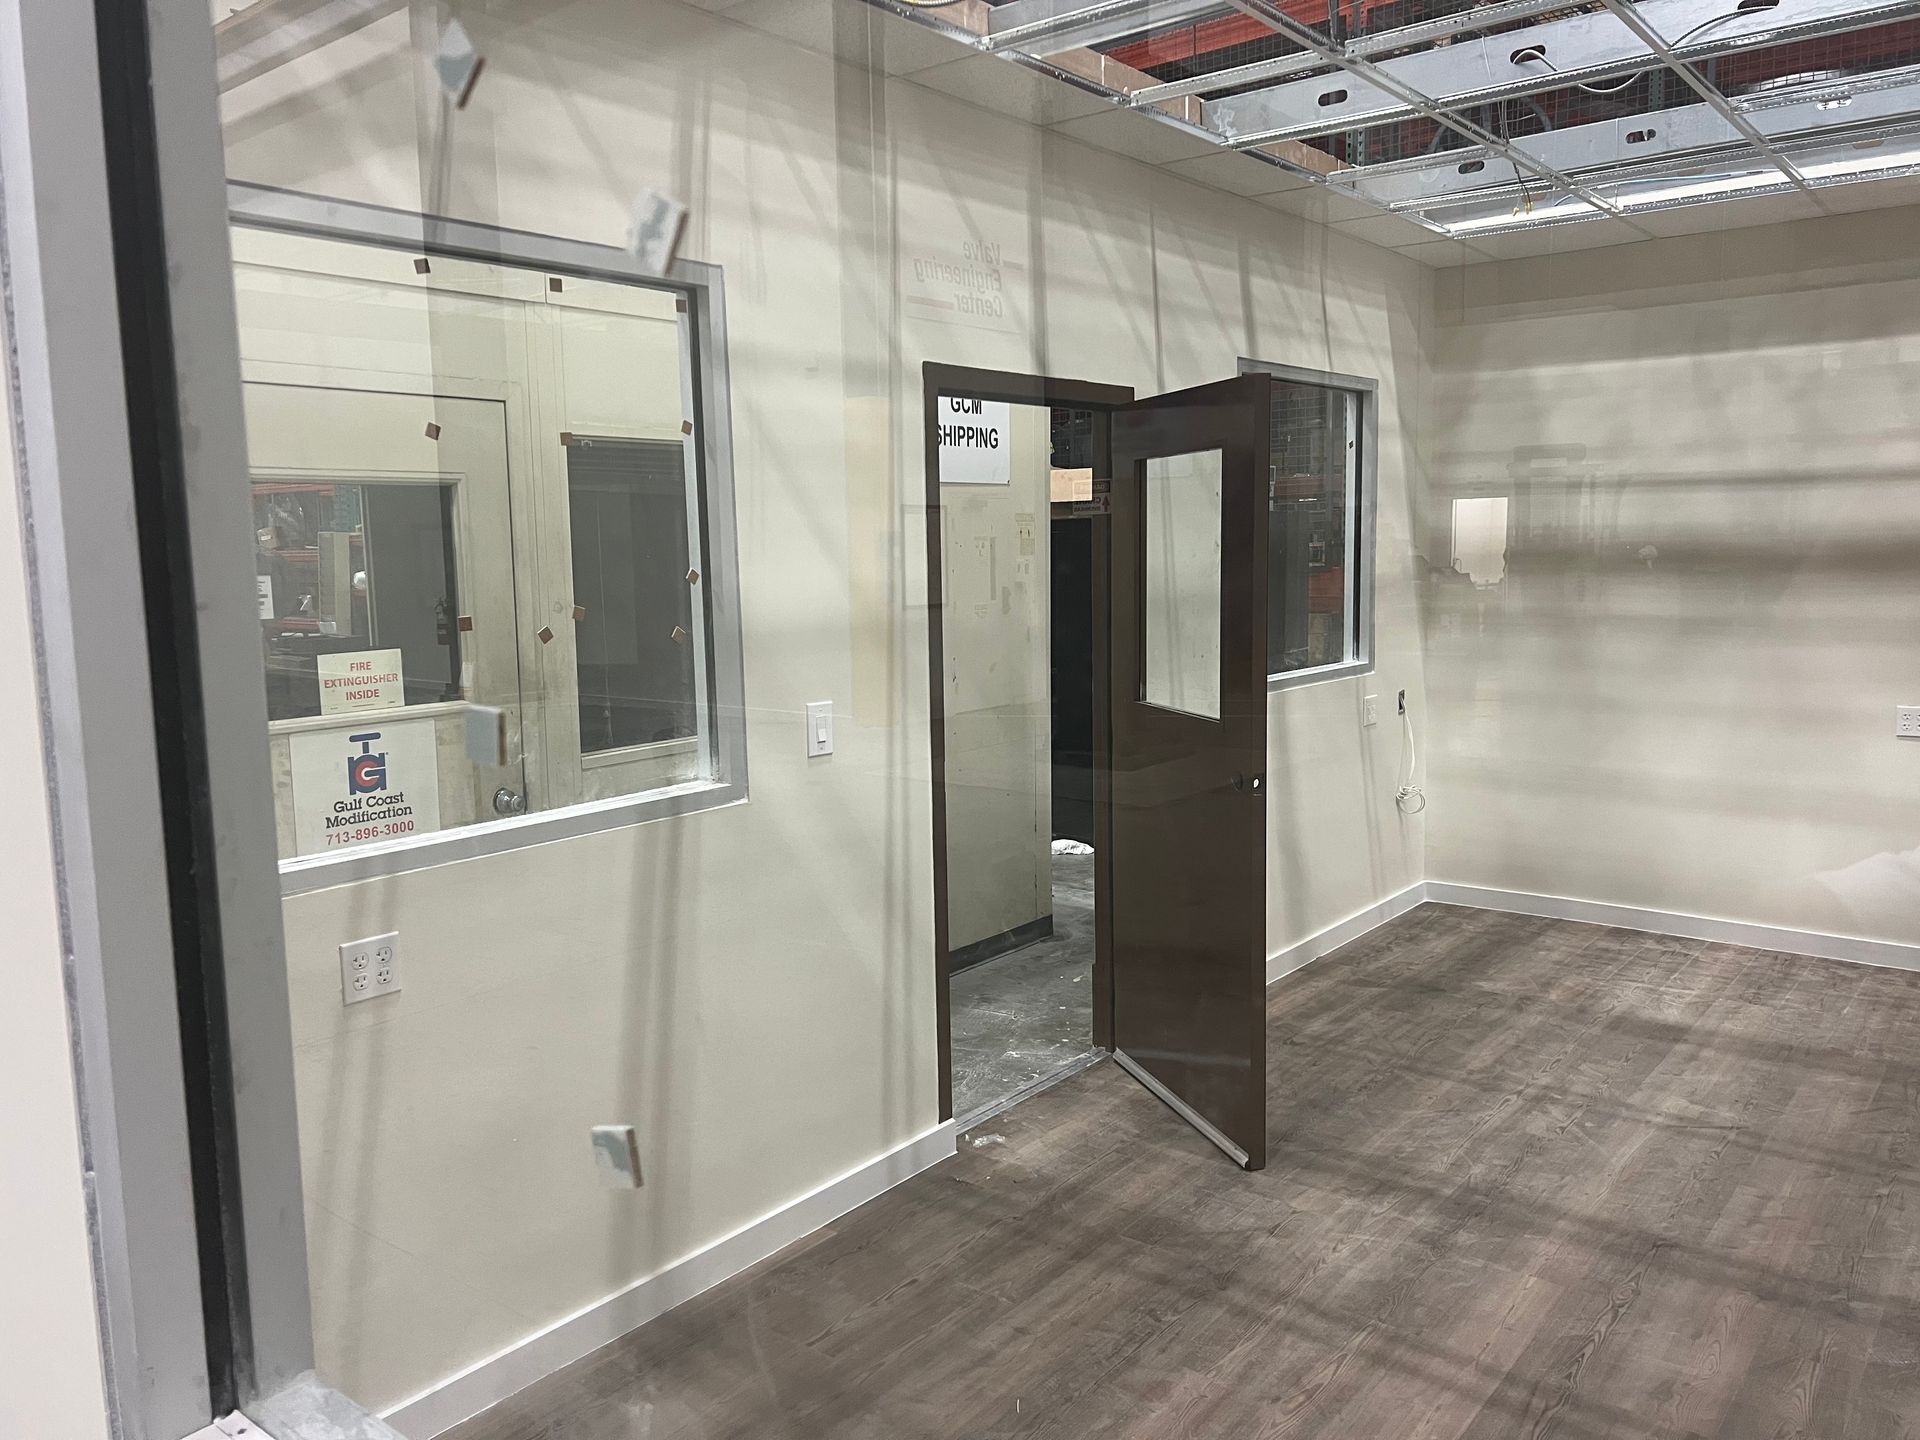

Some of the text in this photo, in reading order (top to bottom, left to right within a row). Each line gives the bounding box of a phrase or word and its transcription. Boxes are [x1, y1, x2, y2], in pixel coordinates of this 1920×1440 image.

[950, 397, 982, 415] GCM
[350, 661, 372, 672] FIRE
[324, 673, 399, 689] EXTINGUISHER
[345, 689, 380, 701] INSIDE
[333, 791, 405, 813] Gulf Coast
[325, 806, 413, 829] Modification
[325, 820, 414, 846] 713-896-3000
